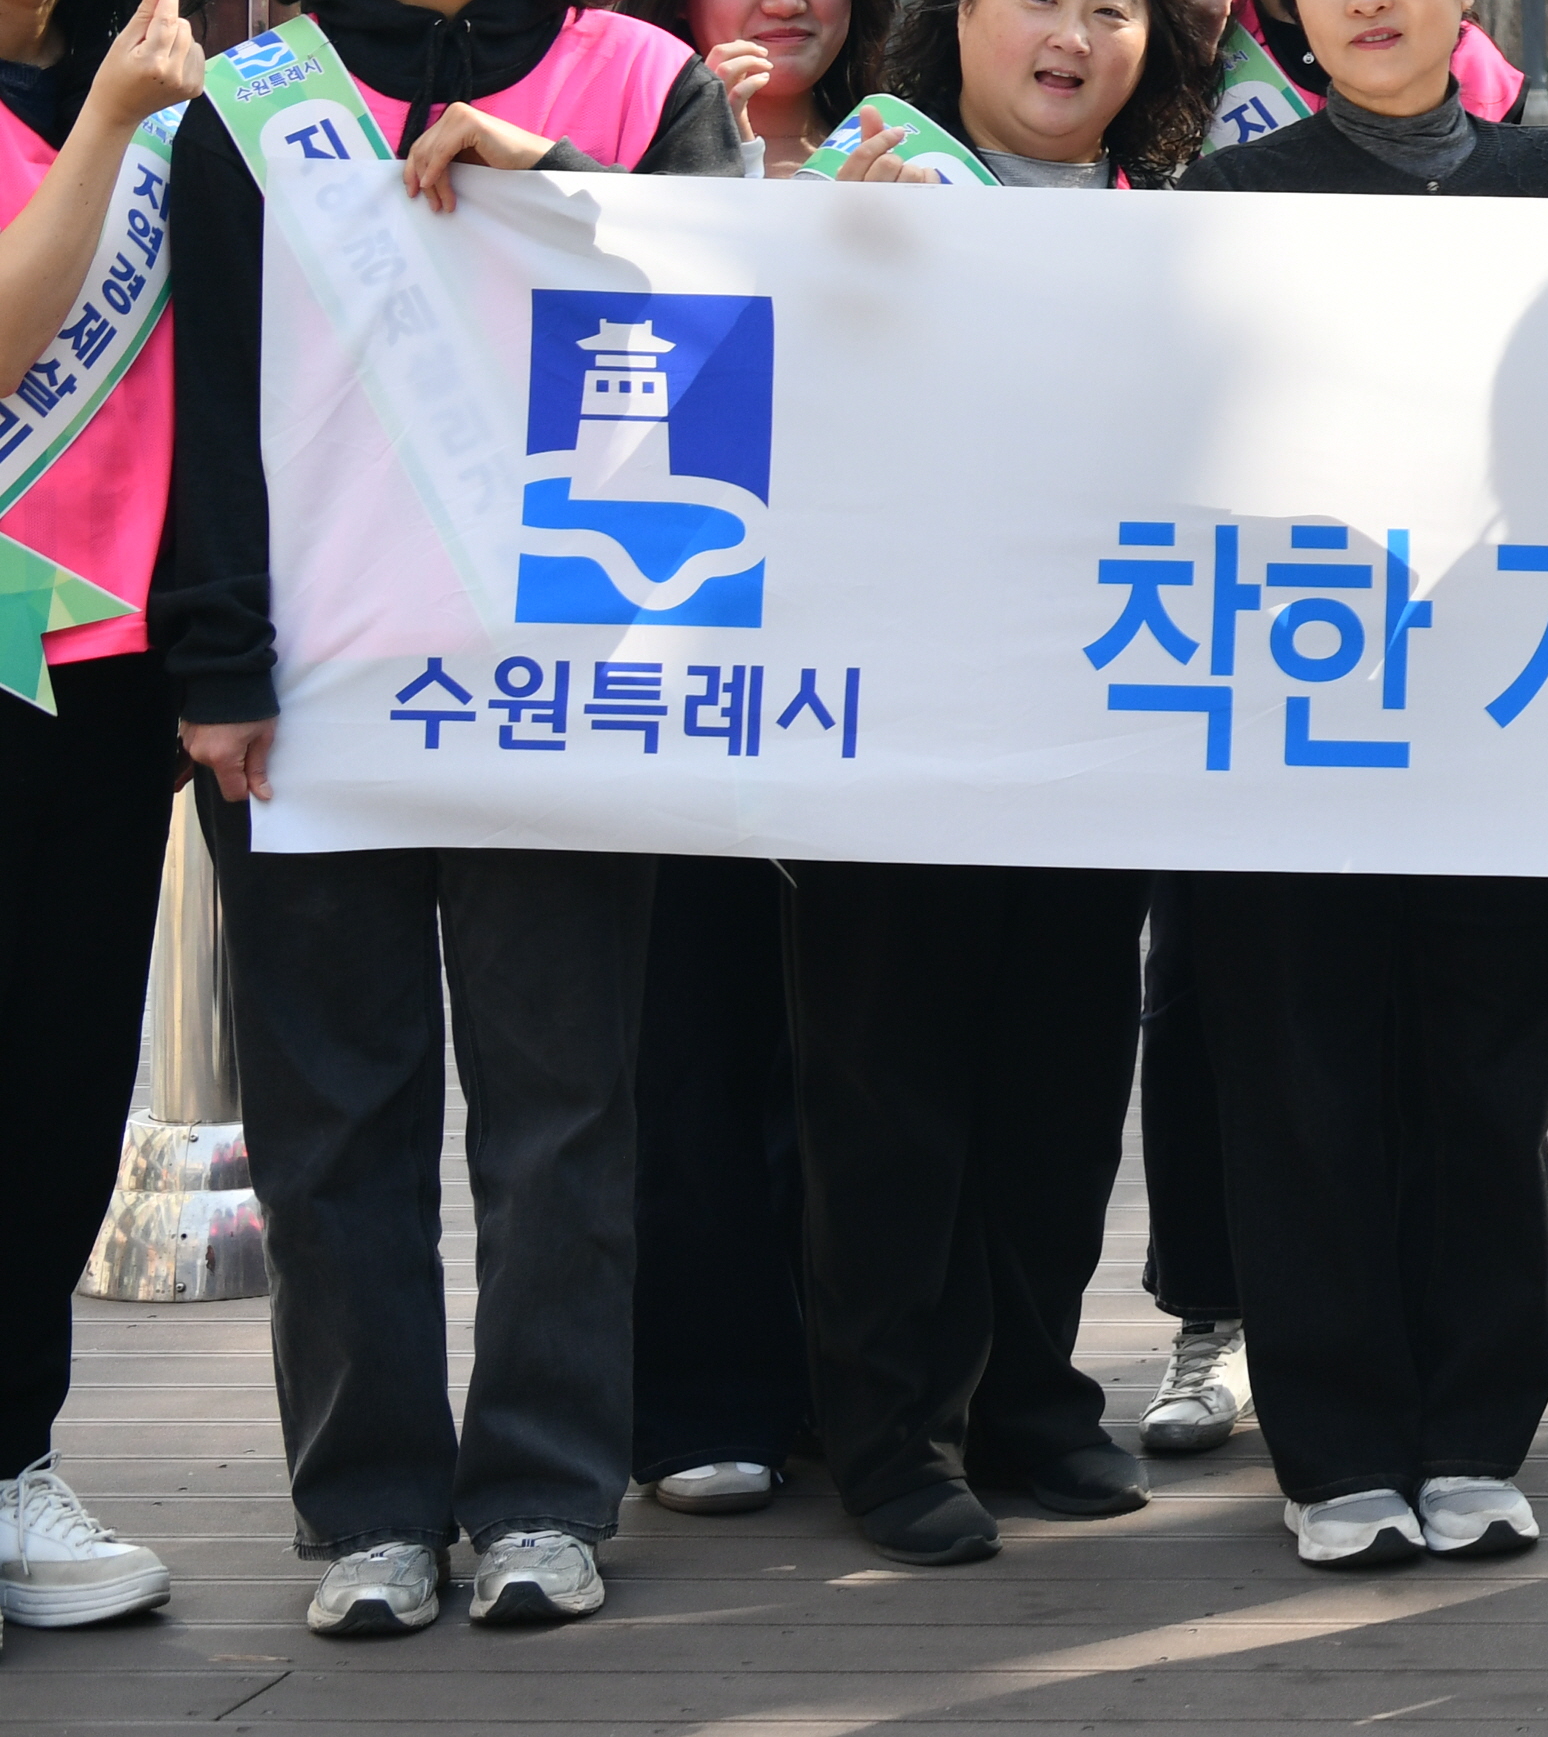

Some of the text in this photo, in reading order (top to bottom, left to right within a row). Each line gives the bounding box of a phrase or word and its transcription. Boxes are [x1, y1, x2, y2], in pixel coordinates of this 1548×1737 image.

[236, 57, 324, 103] 수원특례시
[1082, 521, 1434, 772] 착한
[390, 655, 861, 759] 수원특례시
